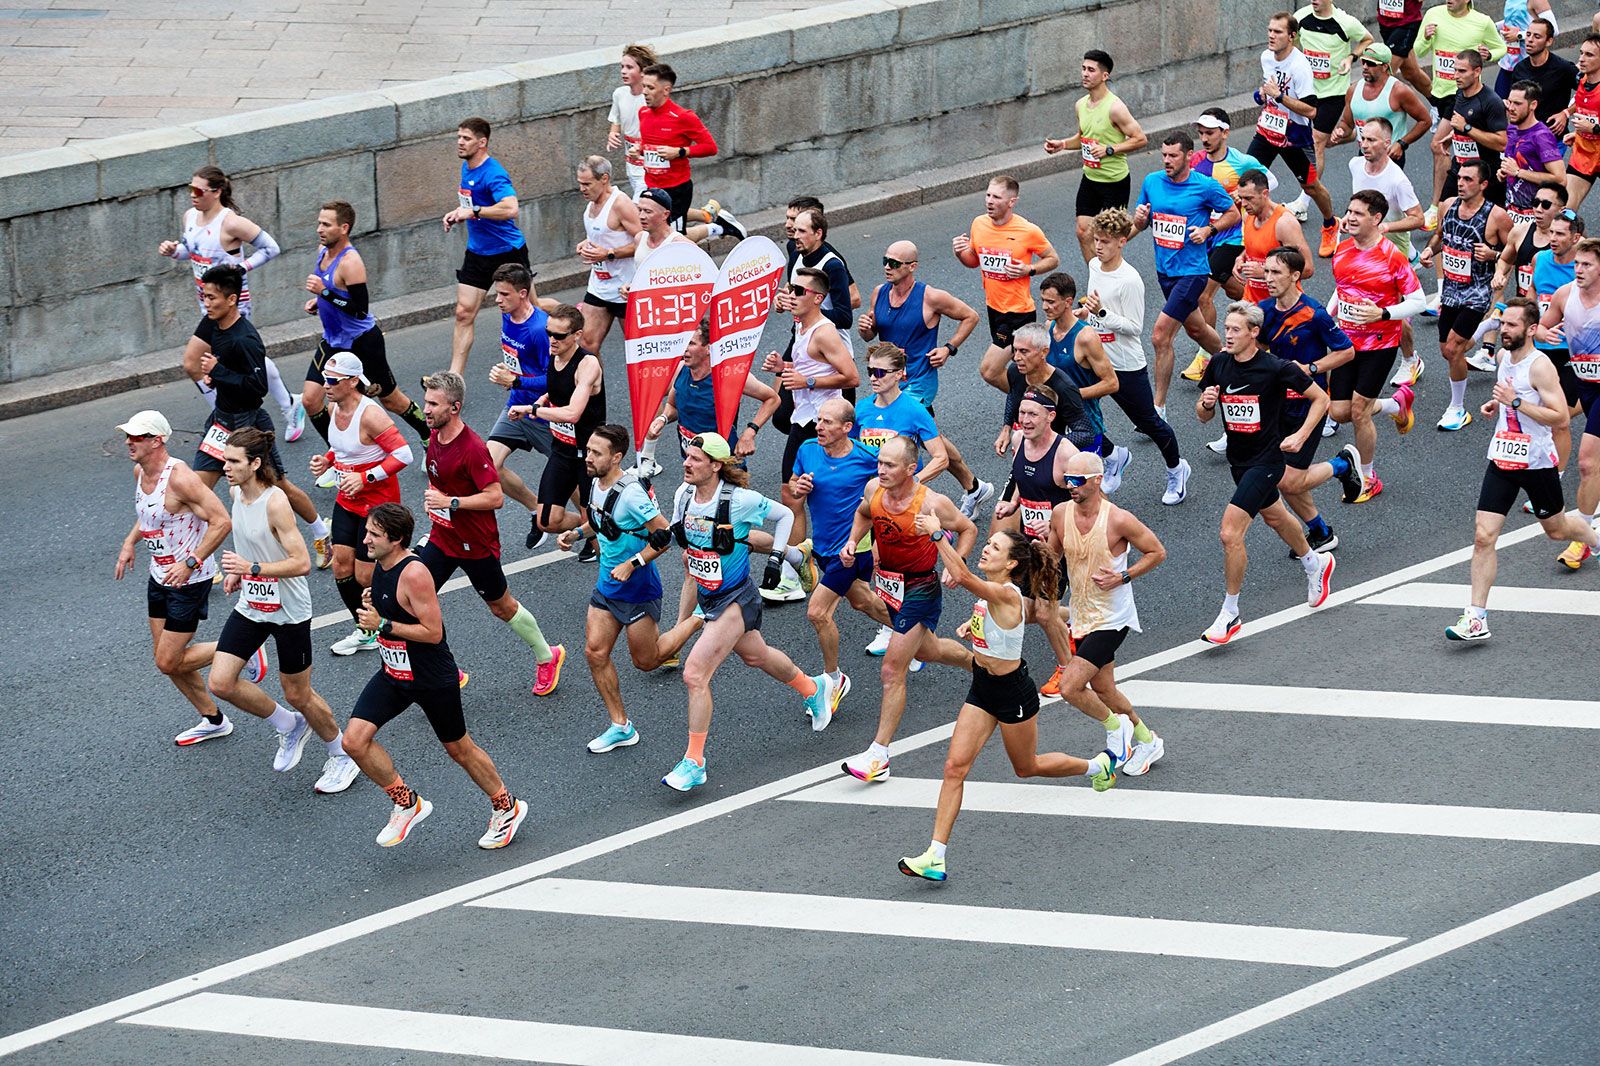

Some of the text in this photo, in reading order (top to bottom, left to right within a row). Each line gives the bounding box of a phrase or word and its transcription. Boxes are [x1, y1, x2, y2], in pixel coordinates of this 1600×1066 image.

[1265, 114, 1284, 128] 9718
[1153, 220, 1184, 236] 11400
[728, 252, 771, 277] МАРАФОН
[983, 255, 1007, 267] 2977
[1445, 254, 1467, 270] 5559
[649, 263, 701, 277] МАРАФОН
[729, 265, 765, 285] МОСКВА
[649, 273, 693, 285] МОСКВА
[635, 292, 697, 329] 0:39
[717, 283, 771, 329] 0:39
[637, 341, 659, 356] 3:54
[1227, 405, 1254, 417] 8299
[1496, 440, 1528, 457] 11025
[688, 556, 719, 574] 25589
[247, 582, 275, 597] 2904
